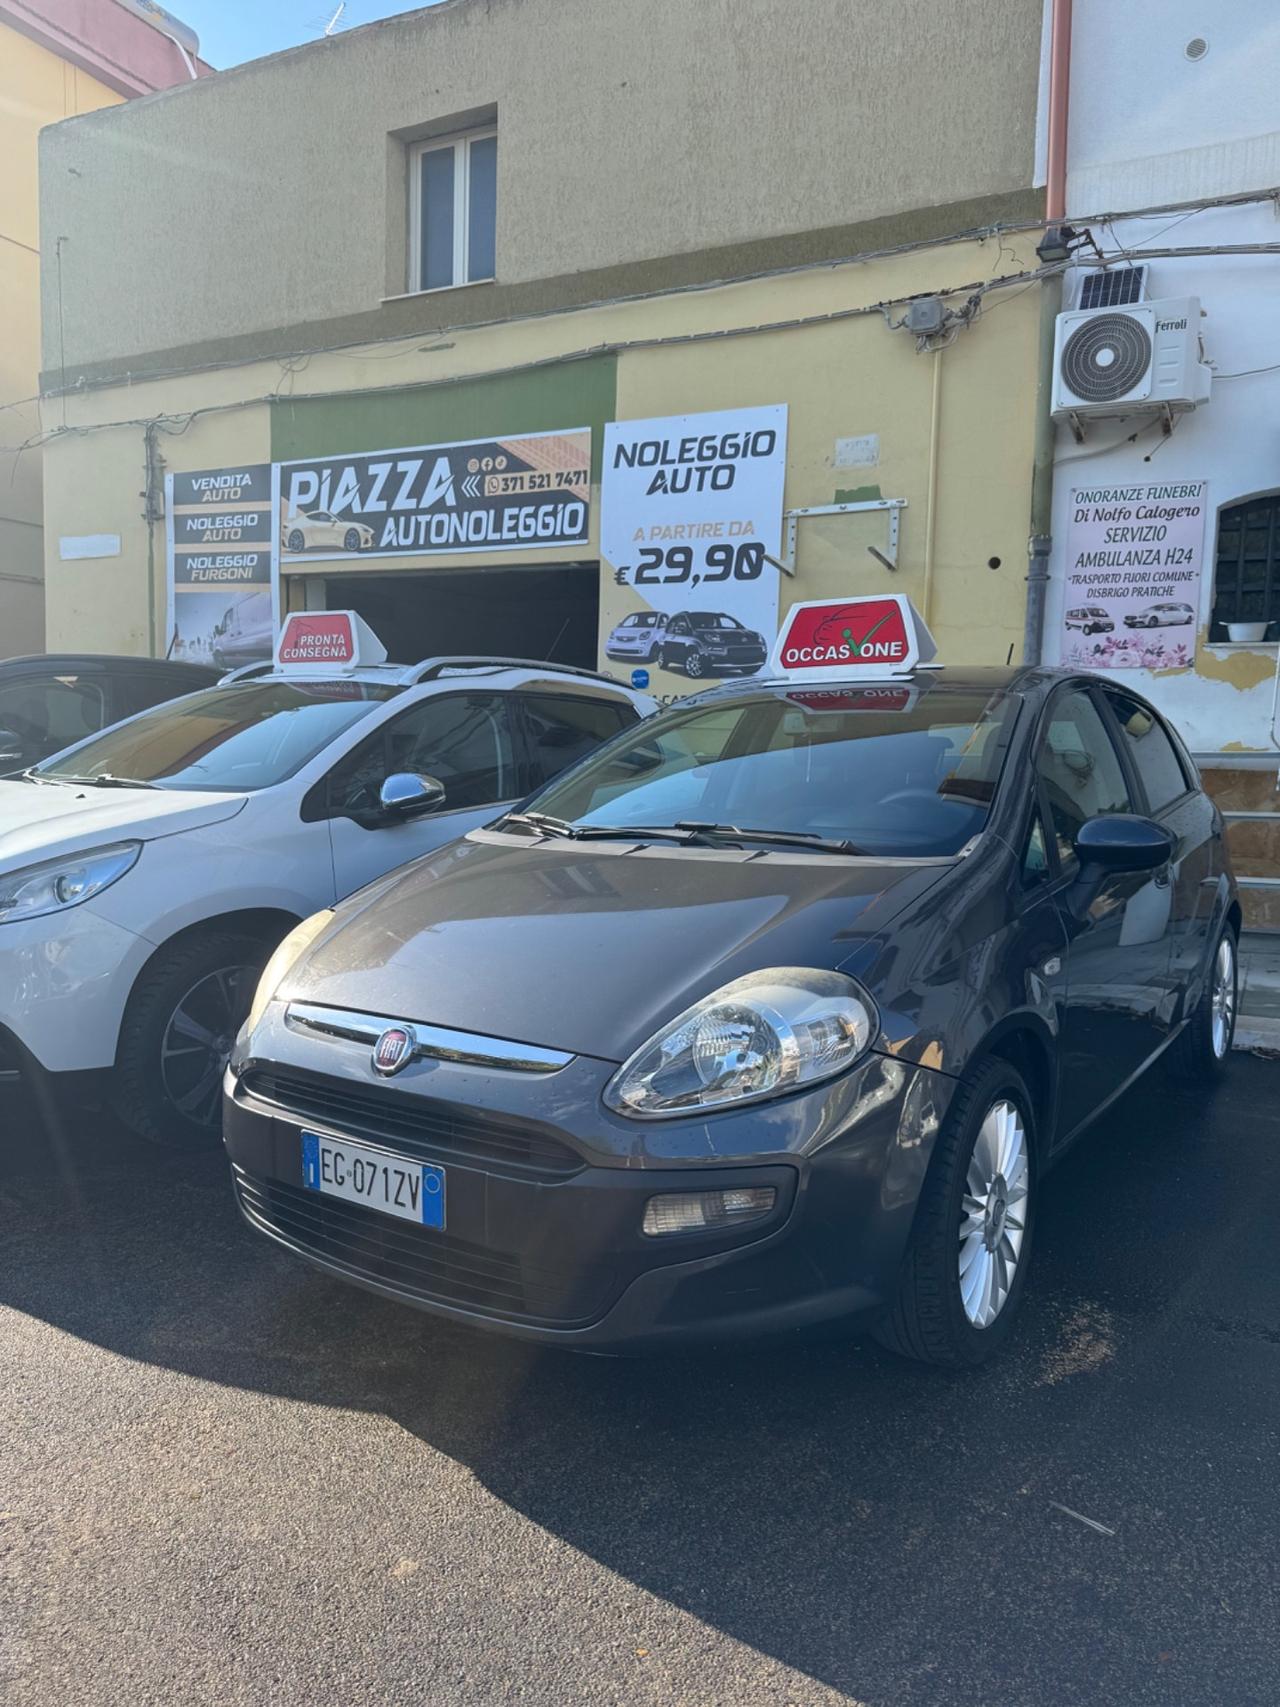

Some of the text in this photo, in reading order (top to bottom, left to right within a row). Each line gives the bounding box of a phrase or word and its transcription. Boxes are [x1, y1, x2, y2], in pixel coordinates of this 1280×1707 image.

[1155, 318, 1187, 333] Ferroli
[191, 473, 252, 491] VENDITA
[501, 469, 588, 492] 371 521 7471
[646, 464, 736, 495] AUTO
[202, 487, 241, 502] AUTO
[1075, 484, 1202, 504] ONORANZE FUNEBRI
[186, 514, 258, 531] NOLEGGIO
[1074, 505, 1200, 523] Di Nolfo Calogero
[202, 528, 242, 541] AUTO
[633, 527, 646, 541] A
[728, 520, 755, 536] DA
[1104, 525, 1167, 544] SERVIZIO
[186, 554, 258, 570] NOLEGGIO
[1075, 547, 1193, 568] AMBULANZA H24
[191, 567, 253, 581] FURGONI
[1071, 571, 1194, 585] TRASPORTO FUORI COMUNE
[1087, 585, 1175, 598] DISBRIGO PRATICHE
[300, 634, 345, 646] PRONTA
[283, 647, 347, 659] CONSEGNA
[379, 1039, 404, 1061] FIAT
